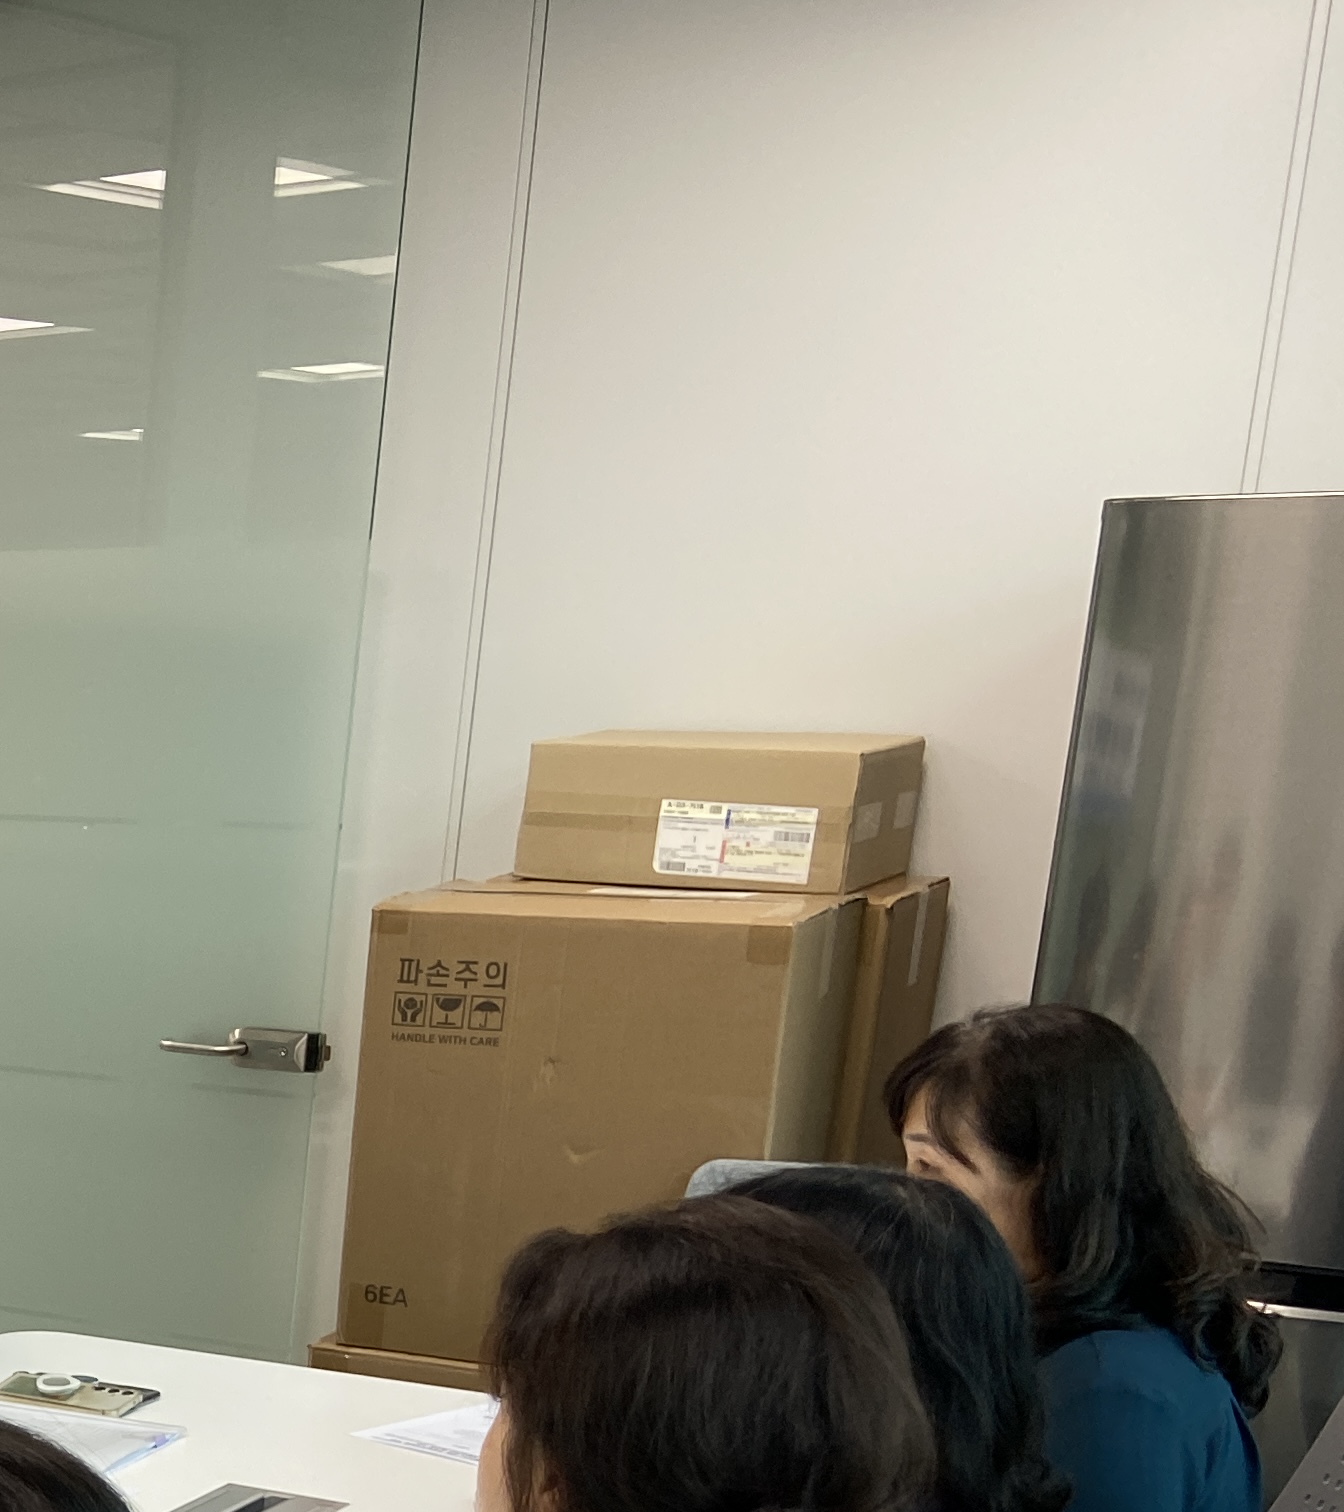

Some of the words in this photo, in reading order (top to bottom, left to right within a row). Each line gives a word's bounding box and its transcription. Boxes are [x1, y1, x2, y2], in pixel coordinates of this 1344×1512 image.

[397, 957, 508, 990] 파손주의
[391, 1031, 435, 1044] HANDLE
[438, 1034, 467, 1046] WITH
[470, 1036, 500, 1047] CARE
[364, 1283, 408, 1308] 6EA
